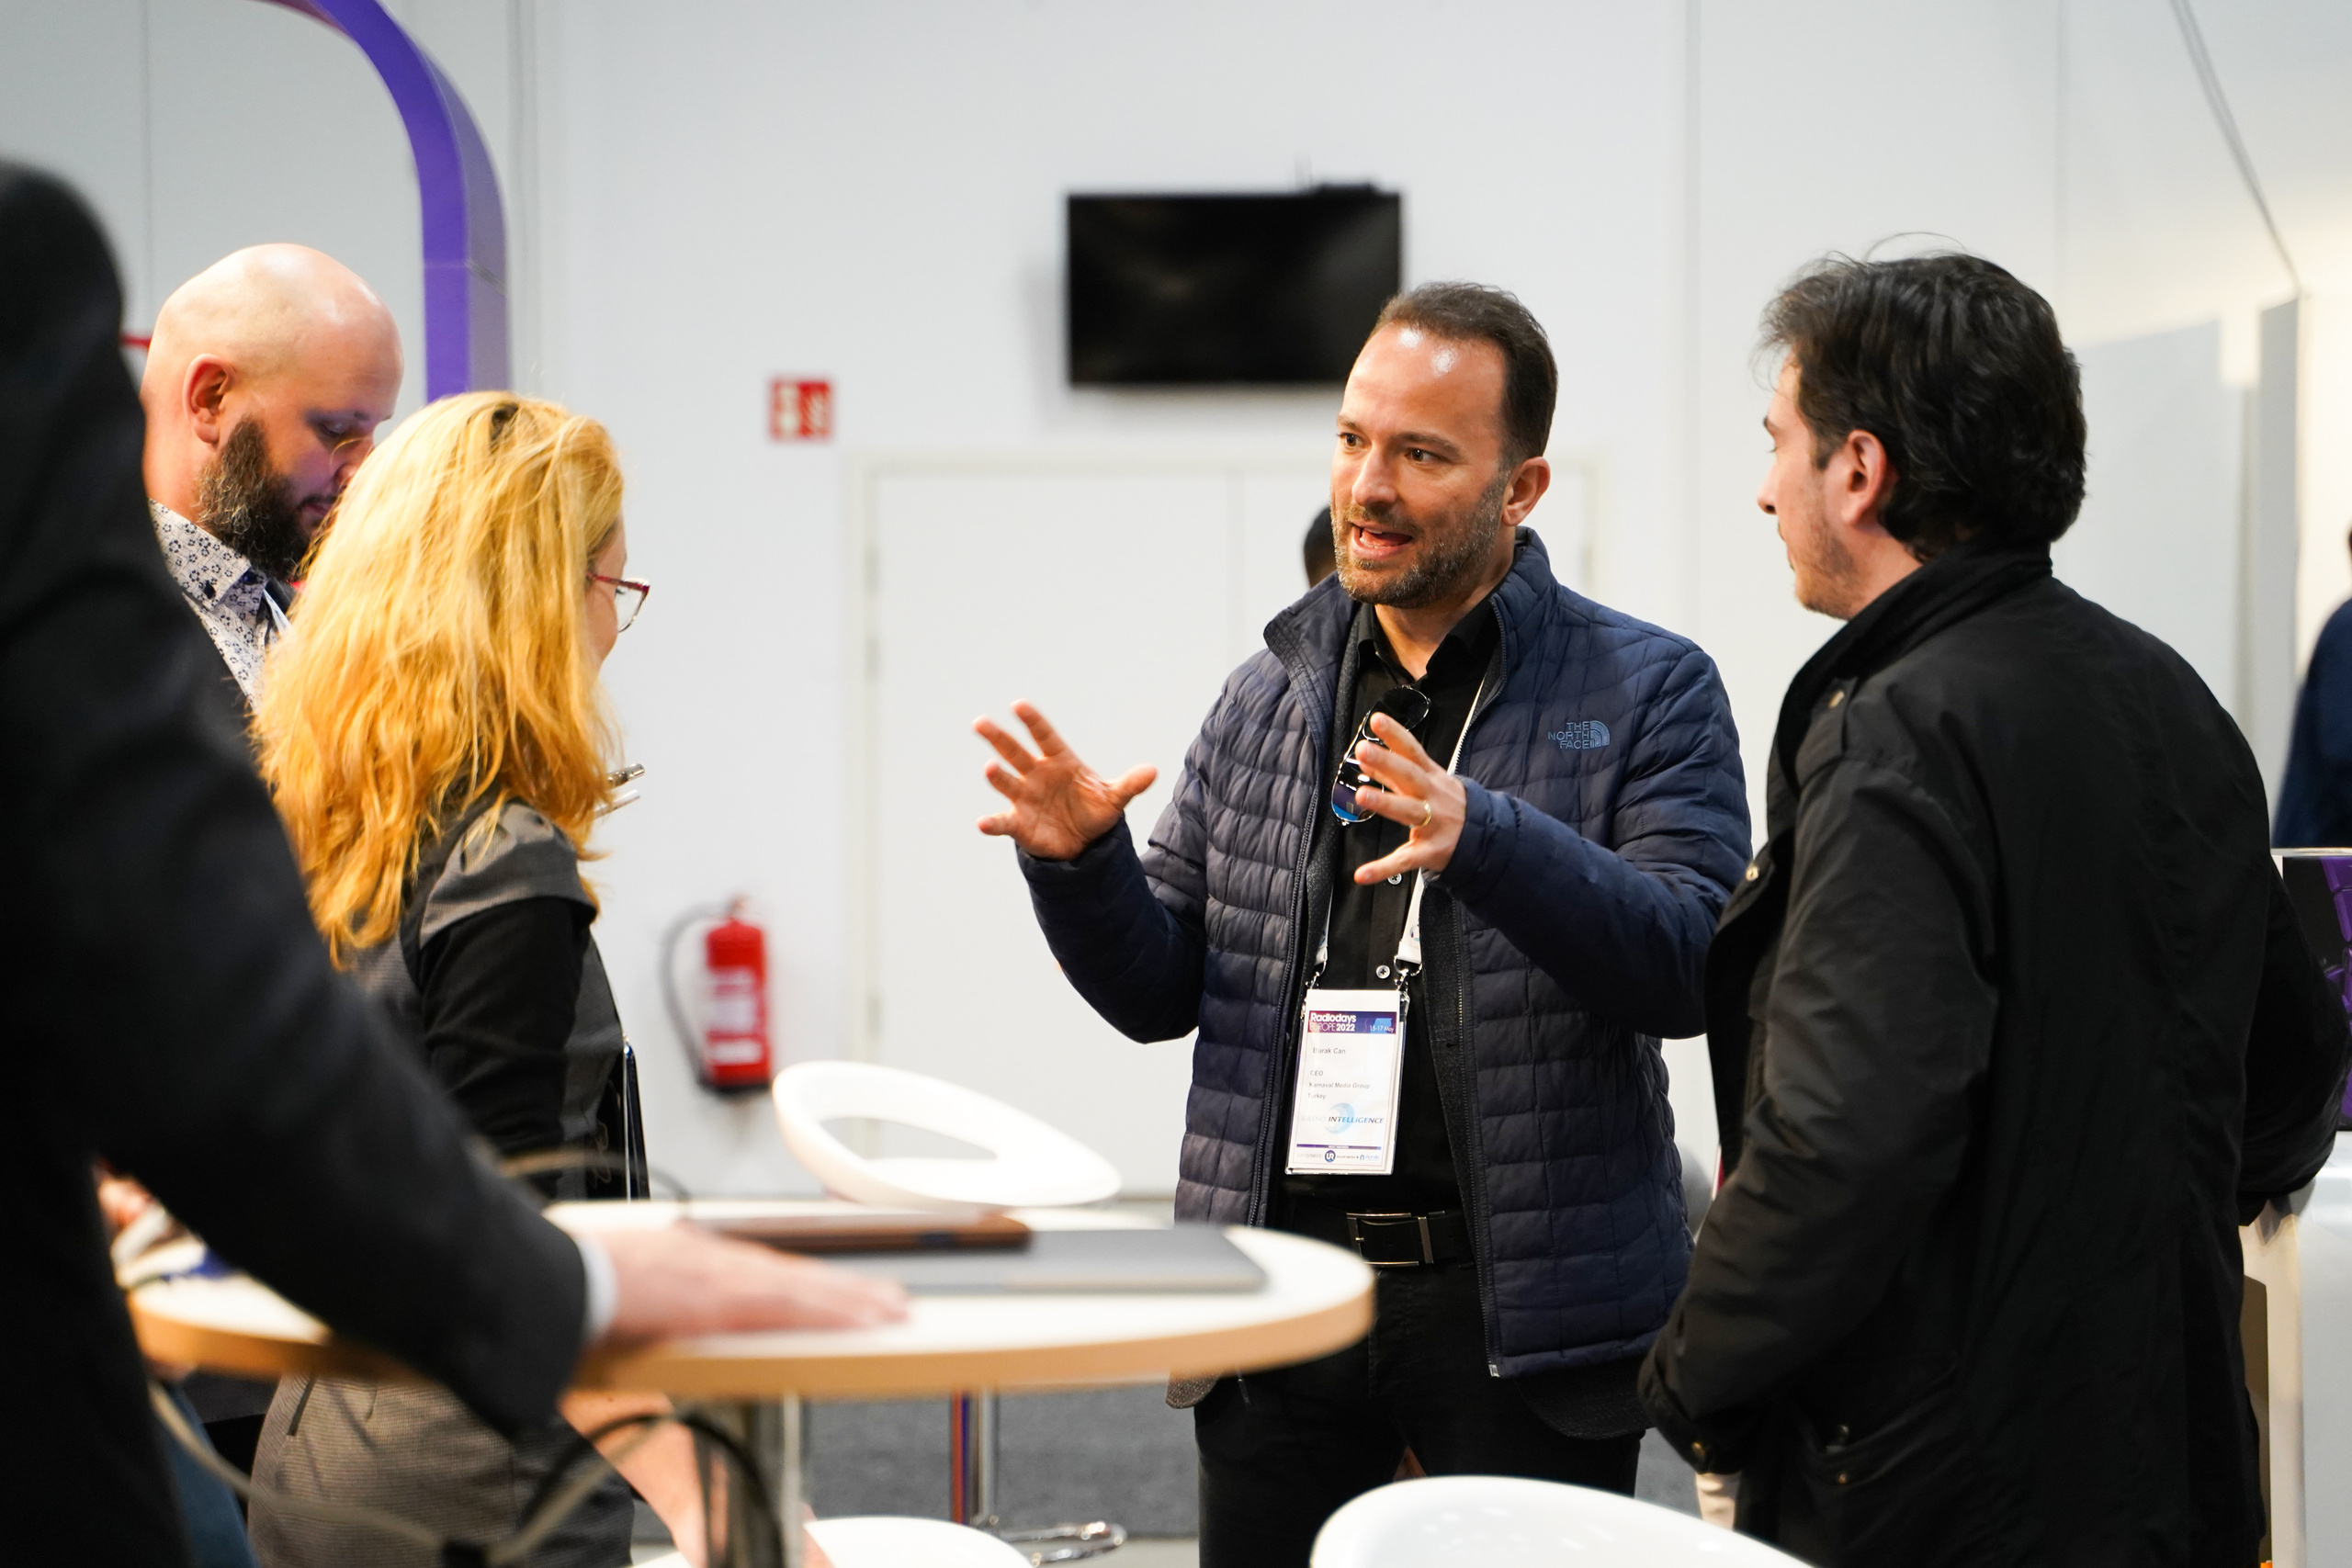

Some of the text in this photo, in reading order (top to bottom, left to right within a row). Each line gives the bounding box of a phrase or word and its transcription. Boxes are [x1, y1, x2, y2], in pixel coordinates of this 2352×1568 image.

[1566, 721, 1589, 731] THE
[1547, 730, 1589, 740] NORTH
[1560, 739, 1589, 749] FACE
[1310, 1012, 1356, 1023] Radiodays
[1336, 1023, 1355, 1032] 2022
